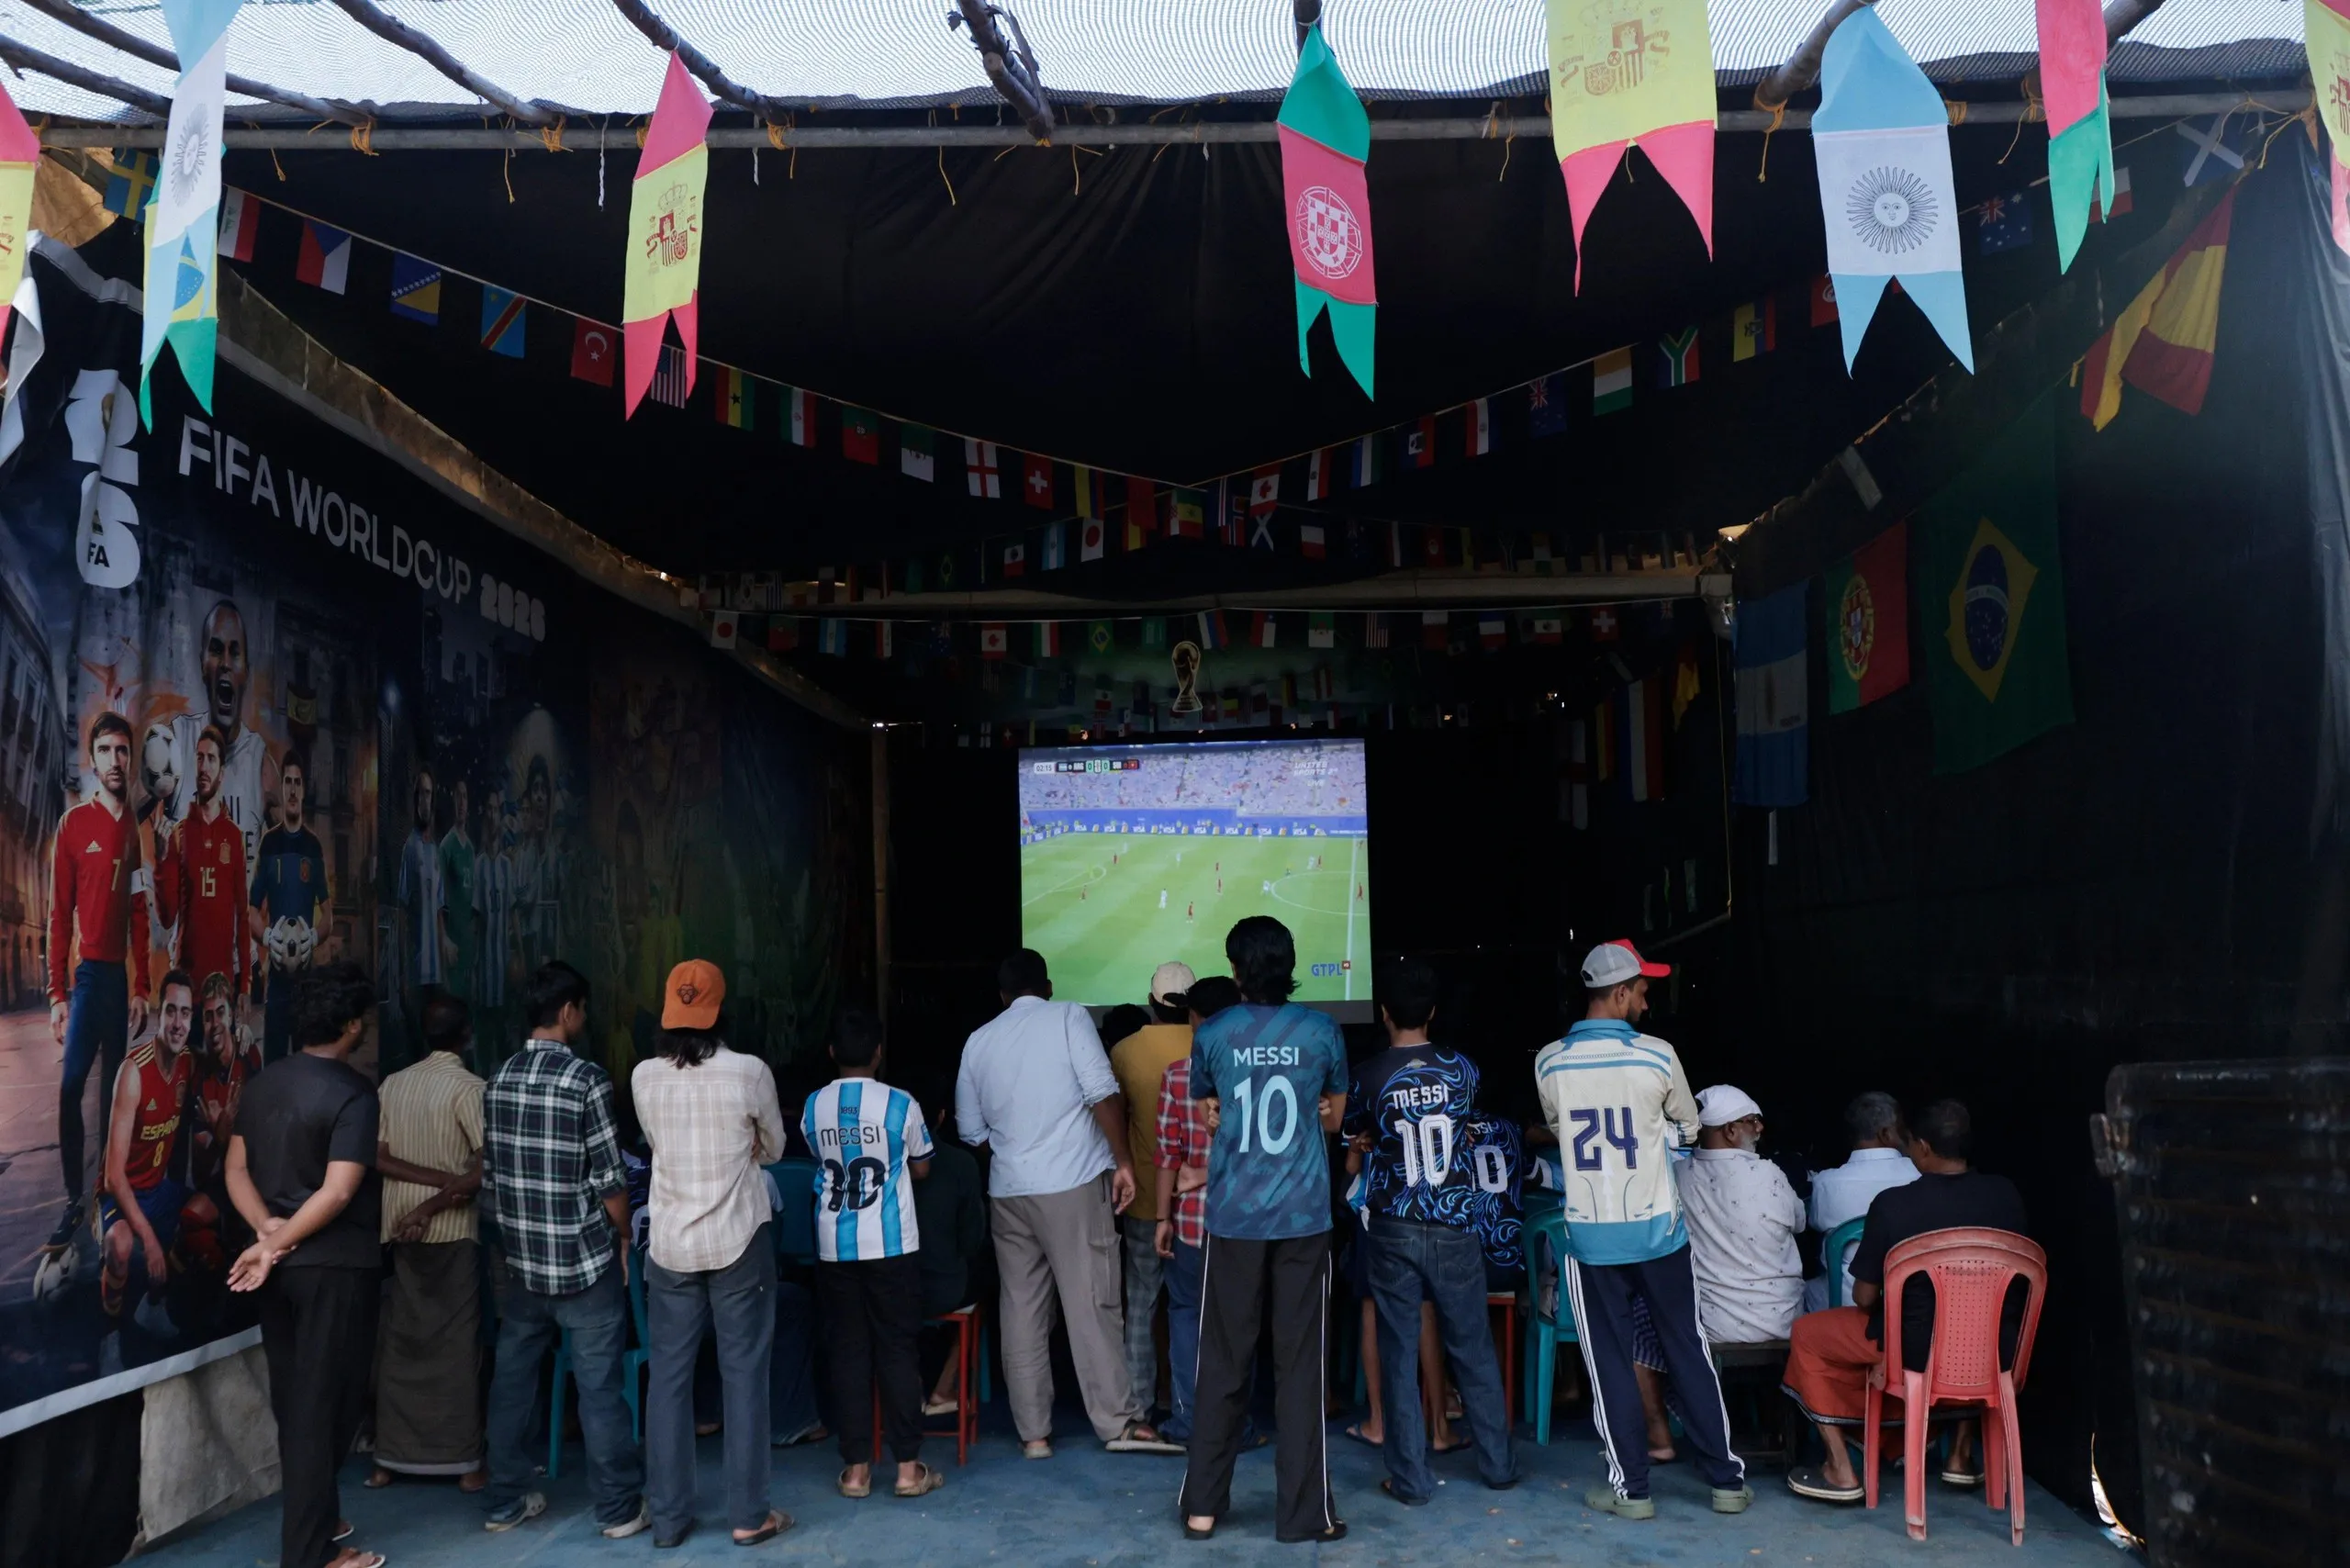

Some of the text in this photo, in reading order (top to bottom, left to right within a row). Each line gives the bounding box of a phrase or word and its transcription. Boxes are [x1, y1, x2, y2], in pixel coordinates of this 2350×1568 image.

[178, 413, 280, 518] FIFA
[479, 572, 546, 643] 2026
[1035, 764, 1053, 772] 02:15
[111, 859, 121, 892] 7
[199, 867, 217, 898] 15
[1311, 962, 1343, 977] GTPL
[1233, 1046, 1300, 1068] MESSI
[1393, 1083, 1450, 1110] MESSI
[1233, 1074, 1298, 1156] 10
[821, 1126, 881, 1147] MESSI
[1570, 1106, 1639, 1171] 24
[152, 1141, 164, 1168] 8
[1393, 1113, 1454, 1193] 10
